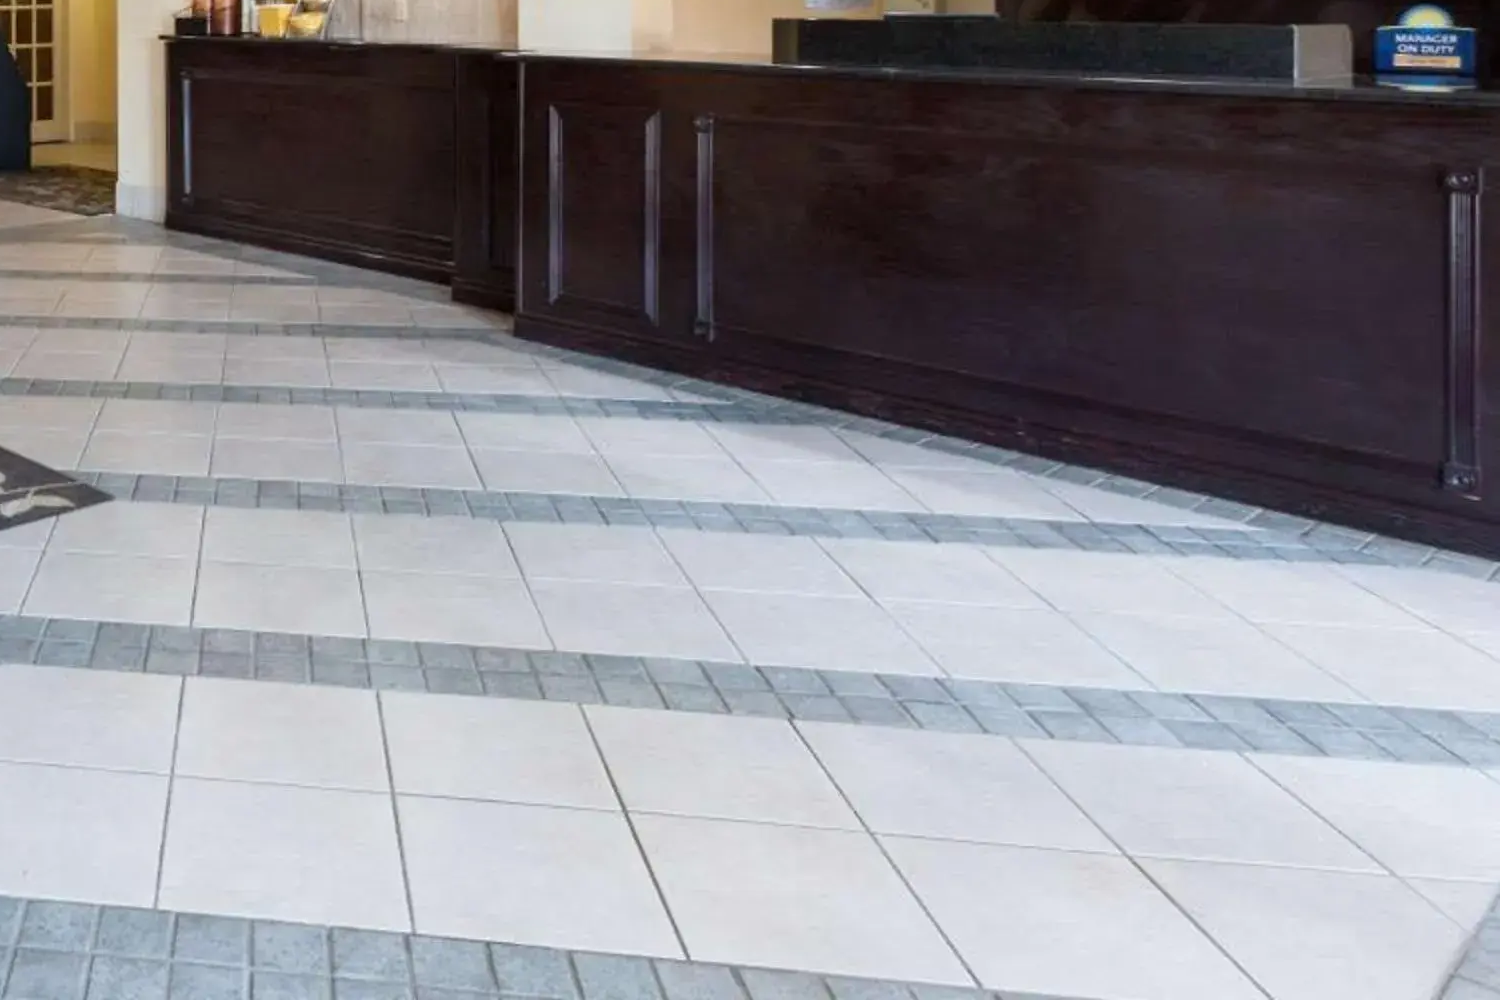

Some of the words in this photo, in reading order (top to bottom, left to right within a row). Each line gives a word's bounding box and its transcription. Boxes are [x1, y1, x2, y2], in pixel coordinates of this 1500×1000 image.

[1395, 33, 1457, 43] MANAGER
[1397, 44, 1418, 53] ON
[1421, 45, 1454, 54] DUTY
